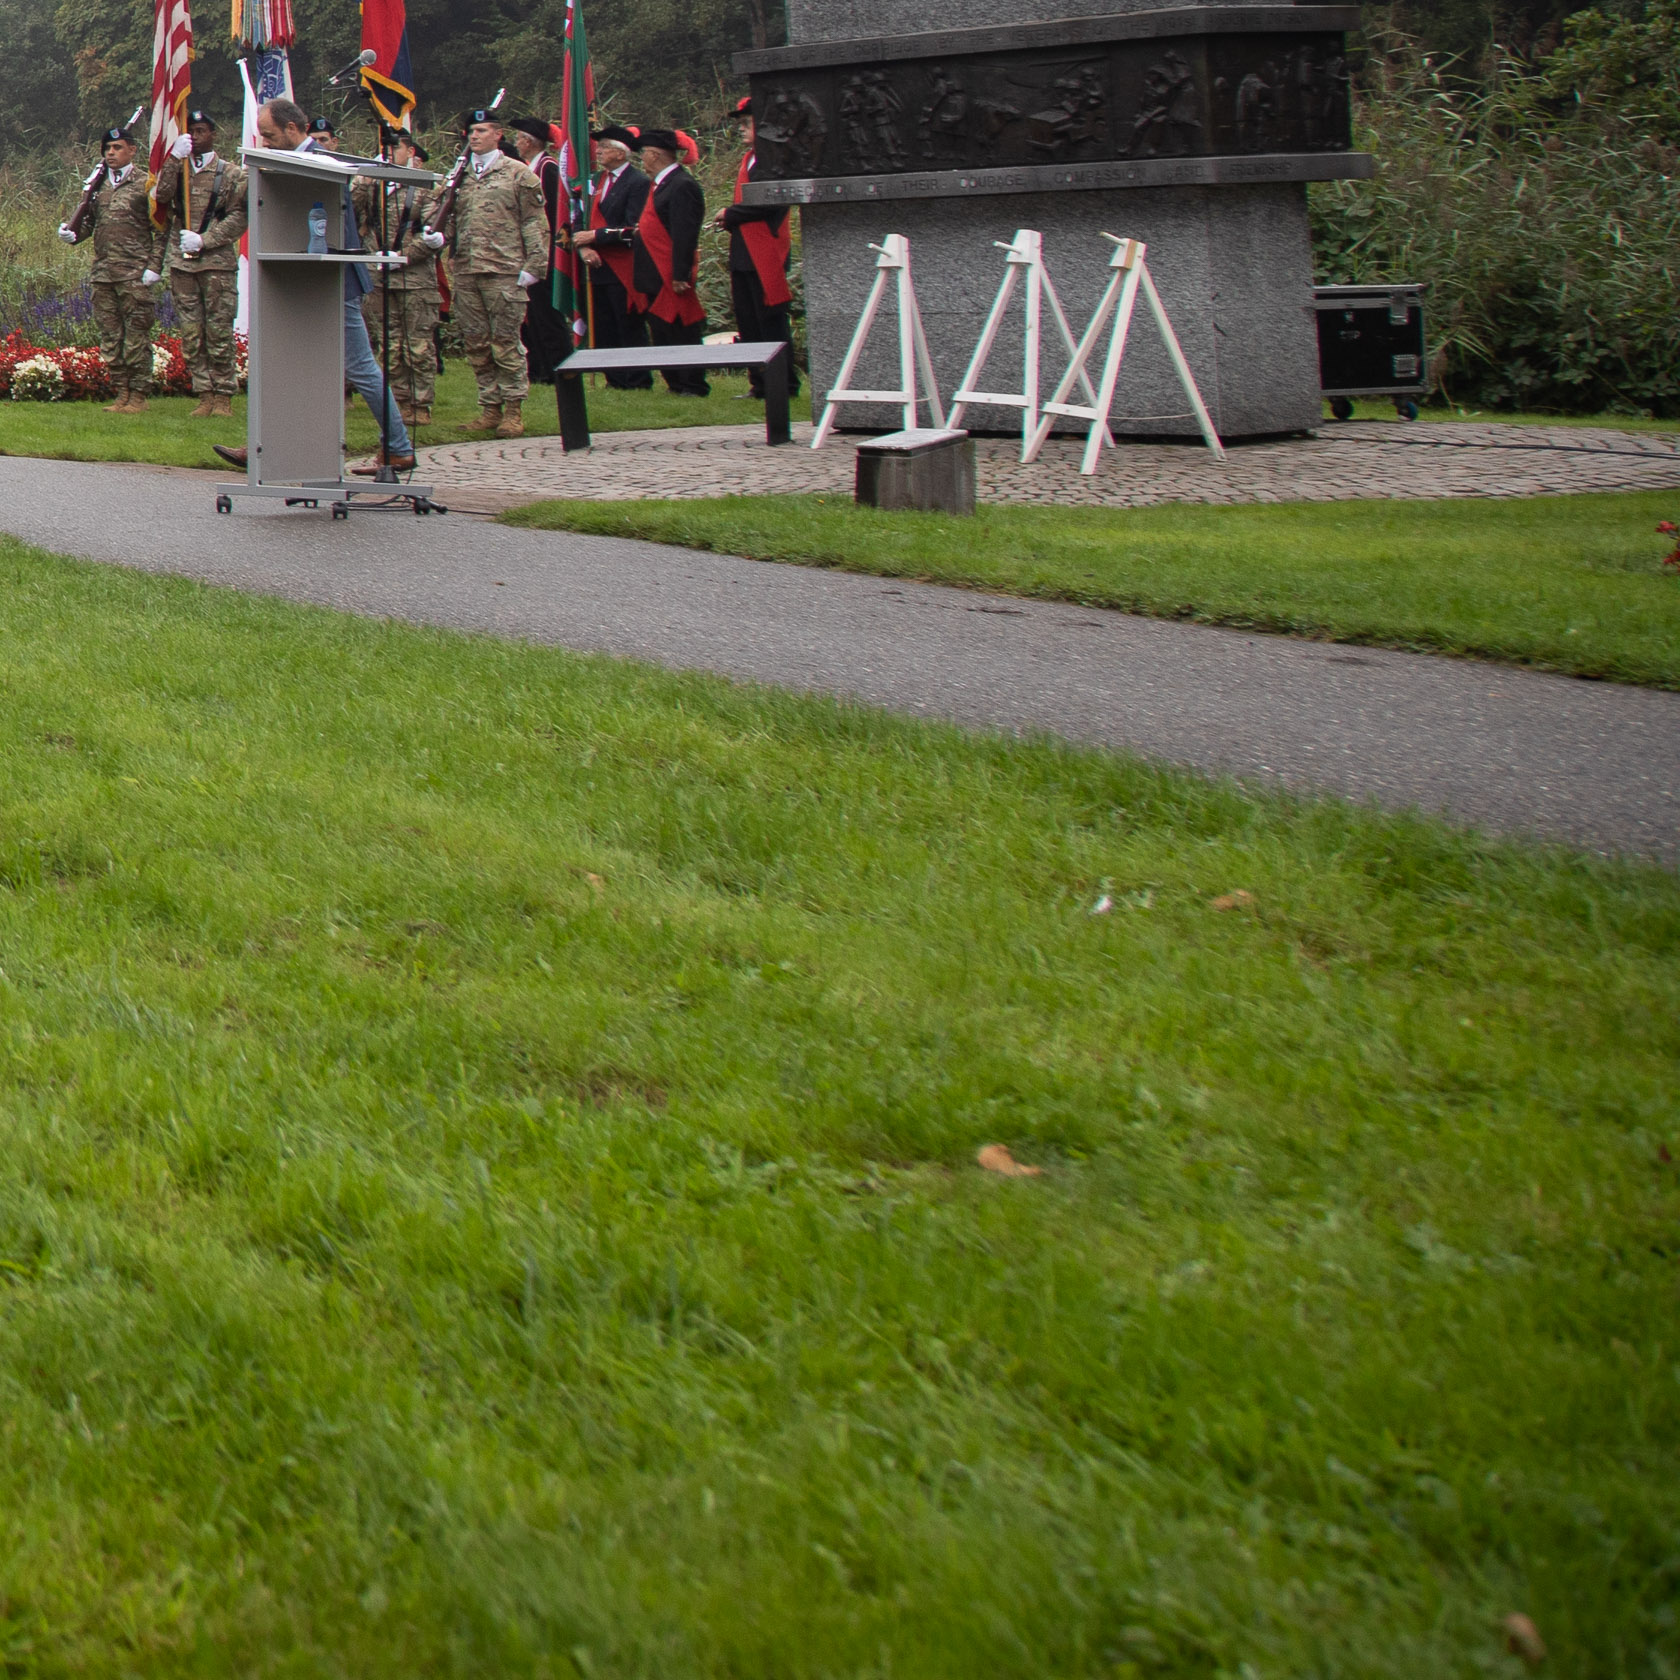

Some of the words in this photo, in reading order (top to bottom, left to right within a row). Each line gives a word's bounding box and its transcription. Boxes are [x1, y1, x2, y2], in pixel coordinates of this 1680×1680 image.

[799, 48, 816, 62] OF
[867, 181, 884, 195] OF
[901, 177, 939, 192] THEIR
[959, 174, 1025, 190] COURAGE
[1055, 167, 1146, 184] COMPASSION
